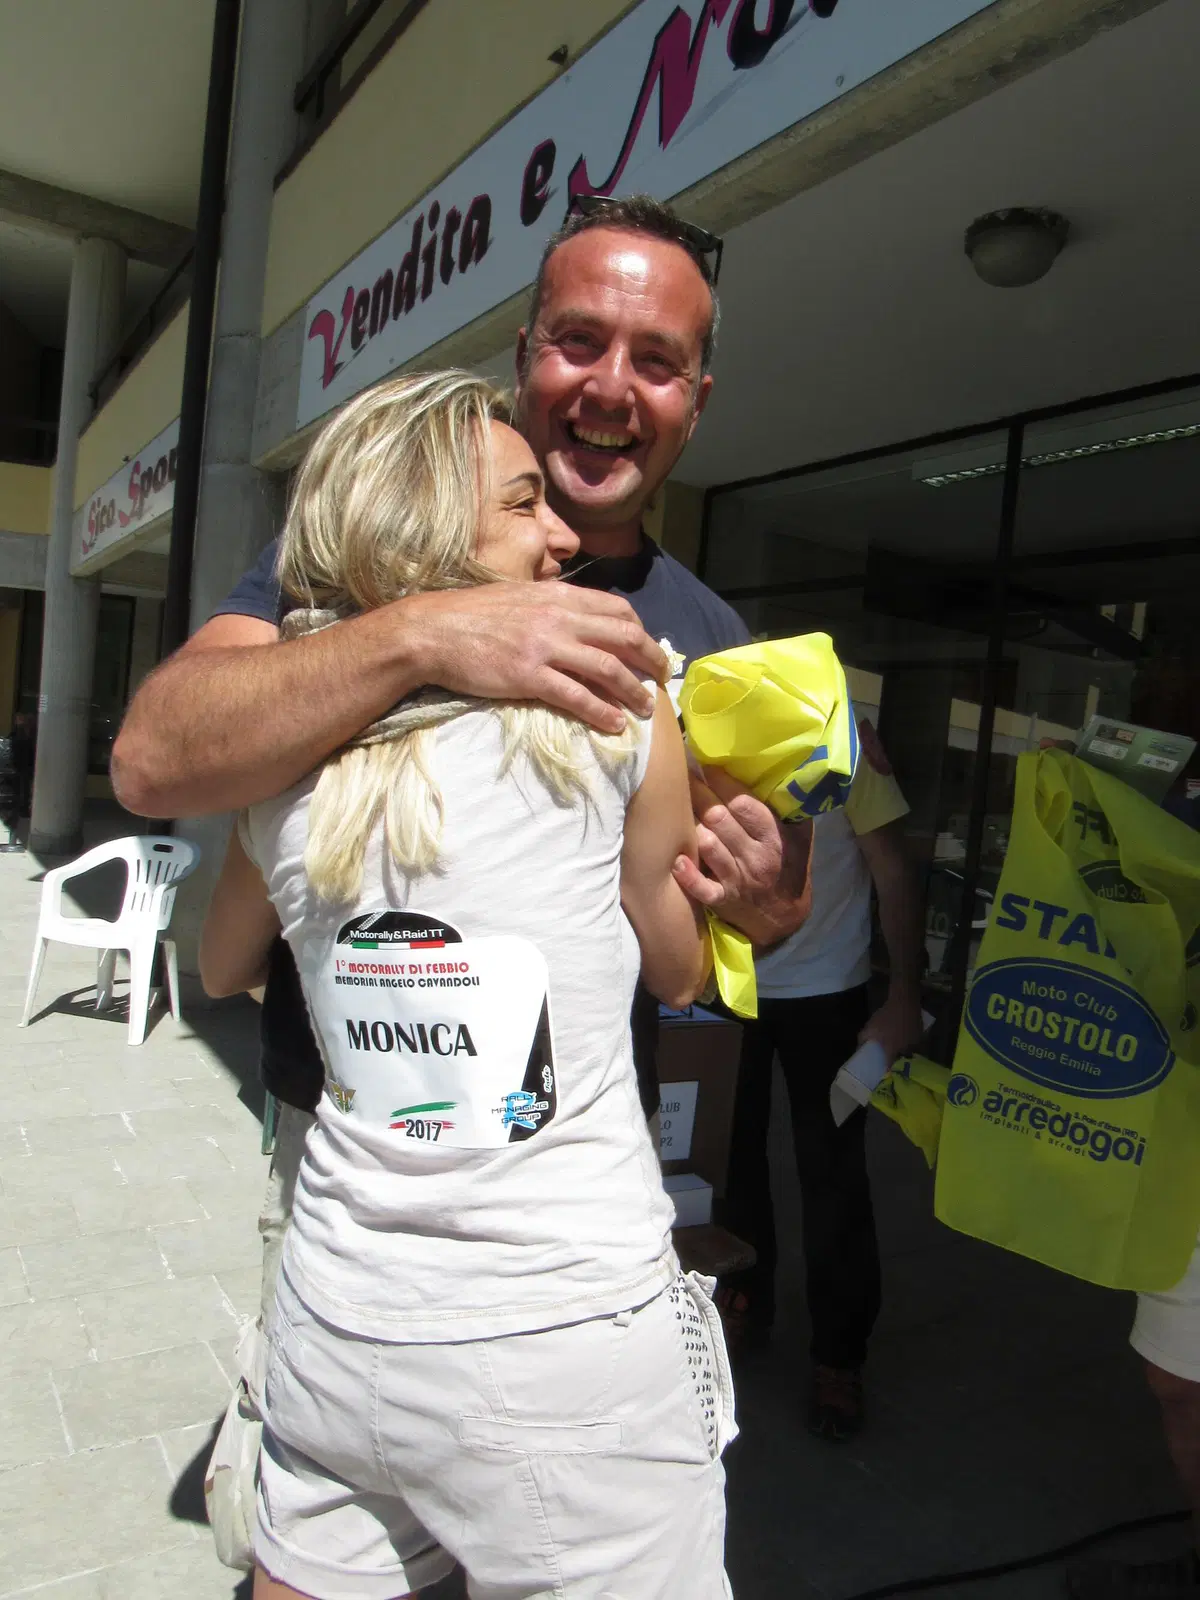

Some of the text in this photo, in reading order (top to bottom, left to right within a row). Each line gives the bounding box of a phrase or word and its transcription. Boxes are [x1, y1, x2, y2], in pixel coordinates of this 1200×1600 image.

[308, 0, 839, 390] Vendita e No
[429, 928, 444, 938] TT
[996, 893, 1117, 959] STA
[335, 975, 480, 989] MEMORIAL ANGELO CAVANDOLI
[348, 962, 405, 975] MOTORALLY
[409, 964, 423, 975] DI
[425, 962, 470, 974] FEBBIO
[1022, 980, 1119, 1022] Moto Club
[345, 1018, 478, 1057] MONICA
[987, 993, 1139, 1063] CROSTOLO
[1011, 1036, 1102, 1077] Reggio Emilia
[491, 1102, 548, 1115] MANAGING
[501, 1094, 536, 1103] RALLY
[406, 1118, 443, 1142] 2017
[501, 1113, 541, 1124] GROUP
[982, 1090, 1147, 1167] arredogoi
